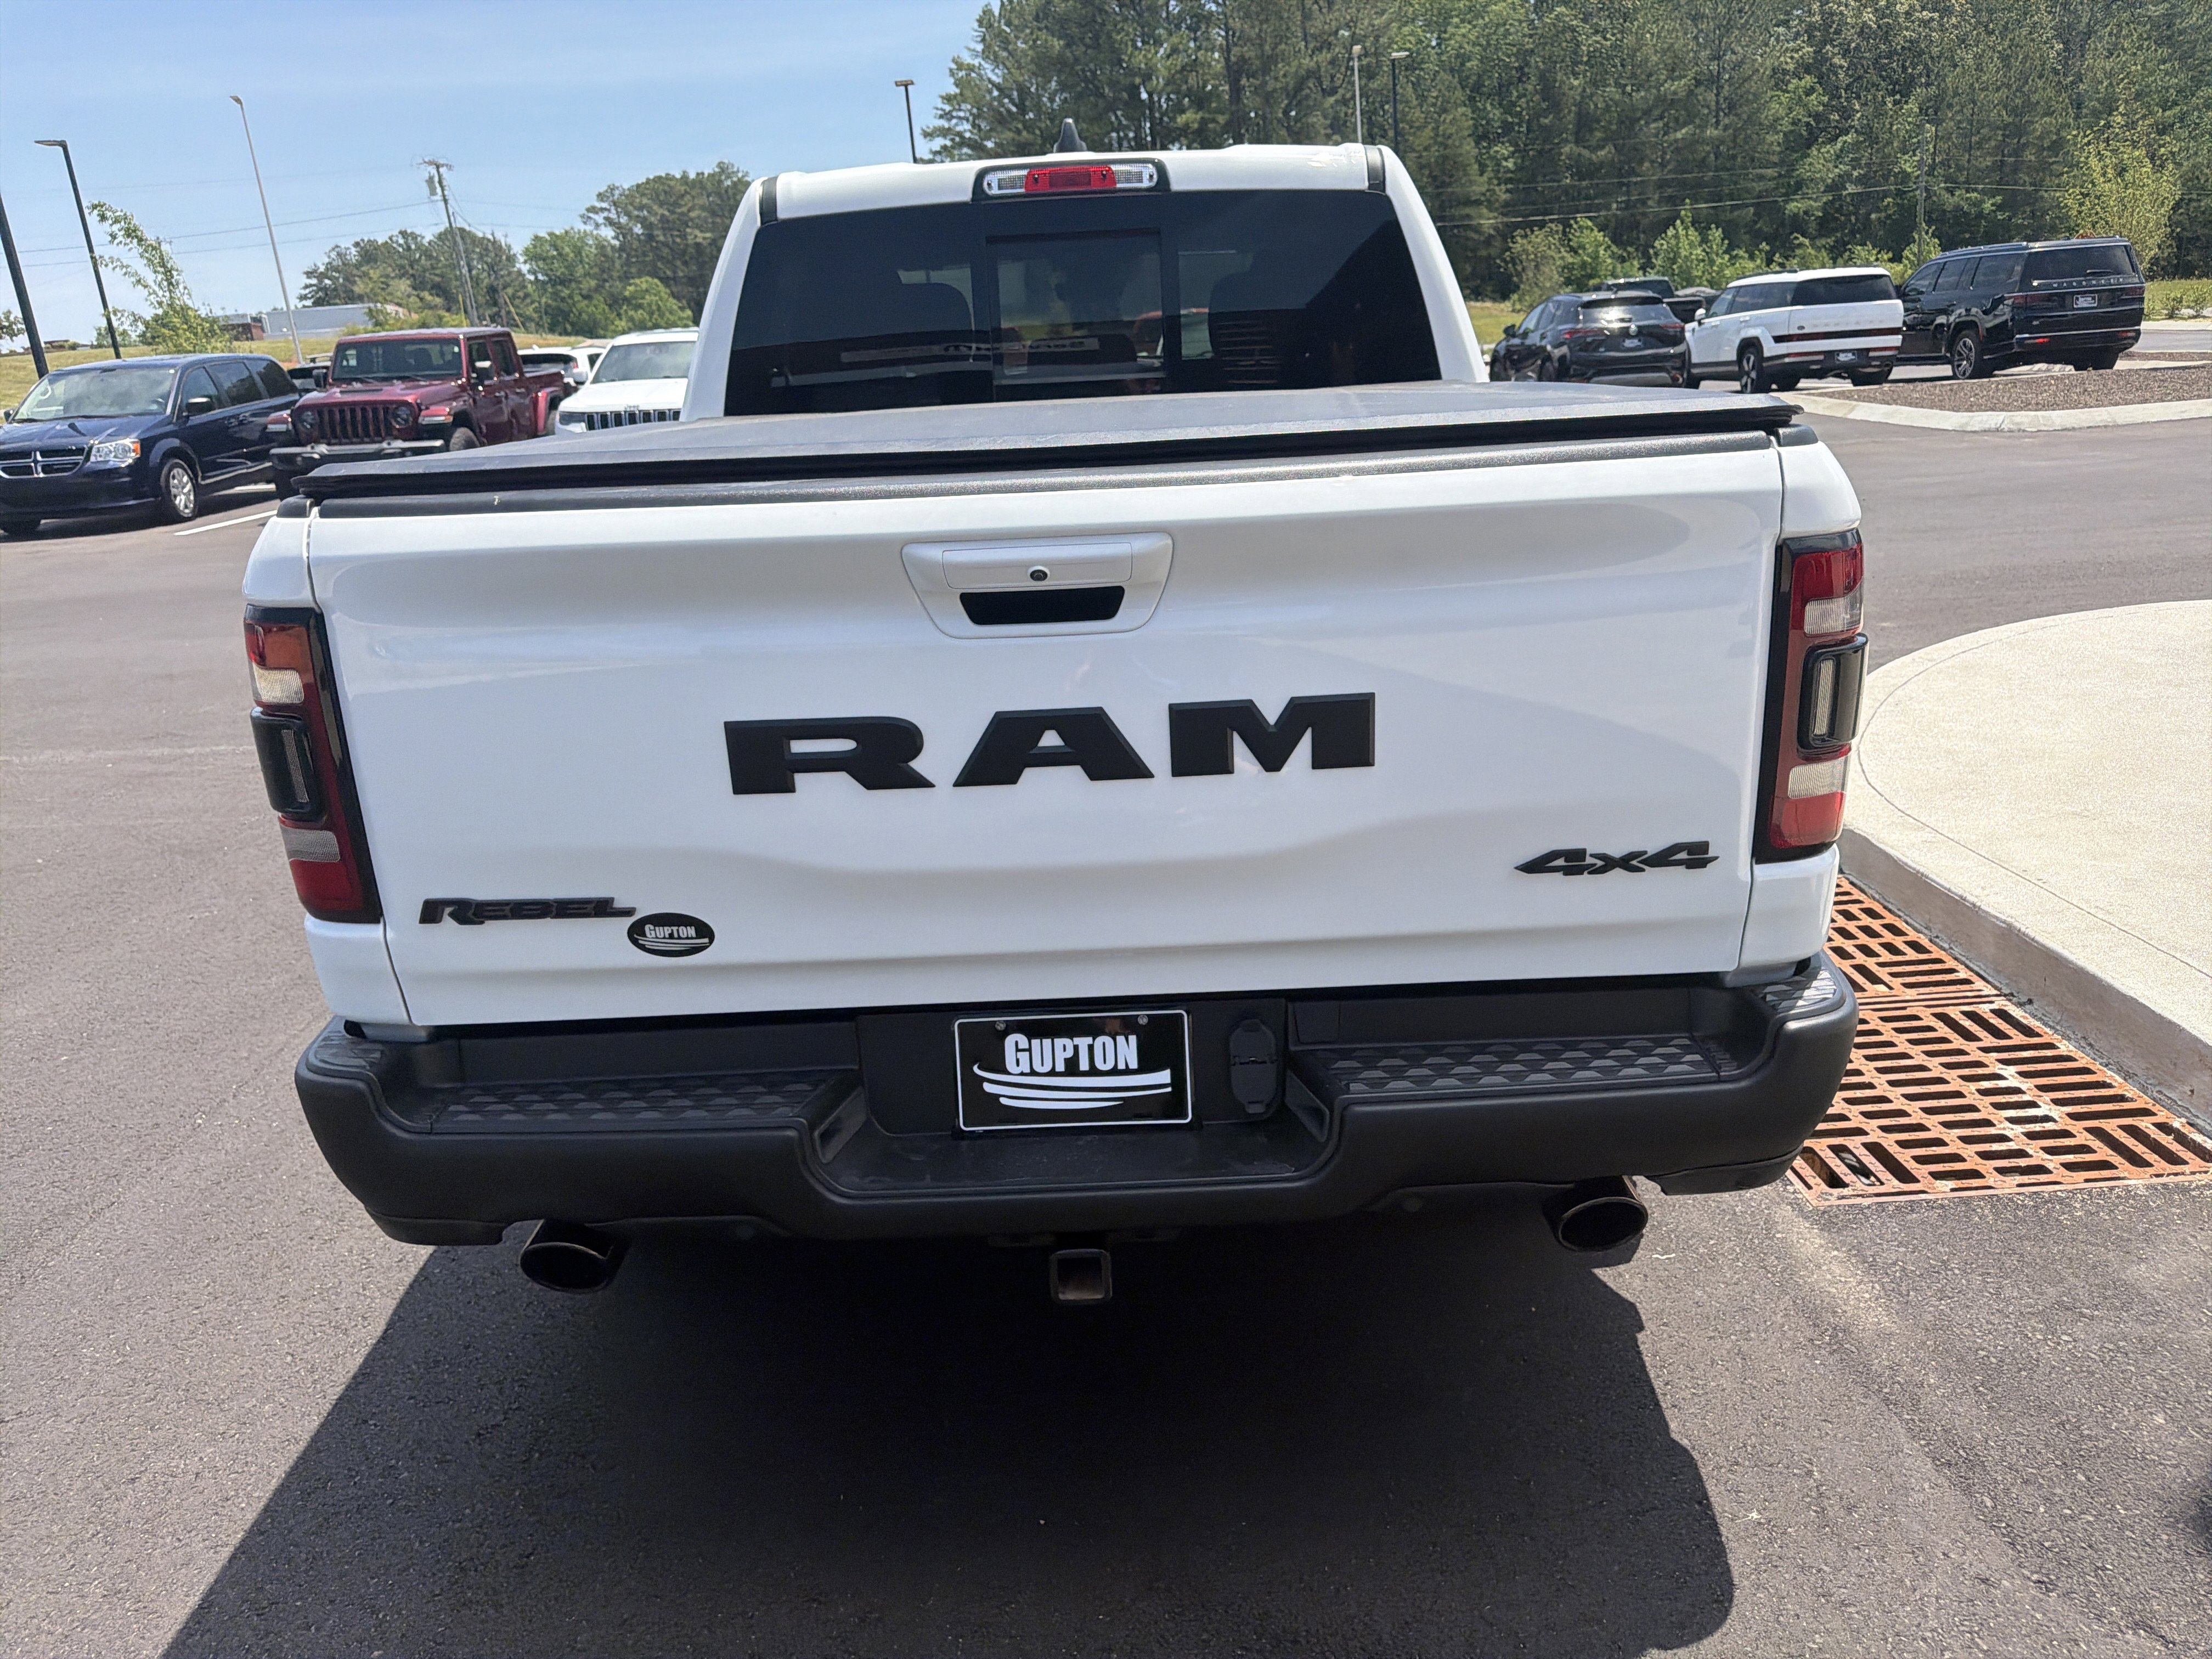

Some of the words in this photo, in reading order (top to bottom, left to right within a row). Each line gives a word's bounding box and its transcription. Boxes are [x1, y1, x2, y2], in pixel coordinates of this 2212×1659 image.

[724, 692, 1375, 795] RAM
[1514, 840, 1720, 876] 4x4
[419, 897, 636, 926] REBEL
[645, 924, 696, 938] GUPTON
[1005, 1033, 1138, 1074] GUPTON
